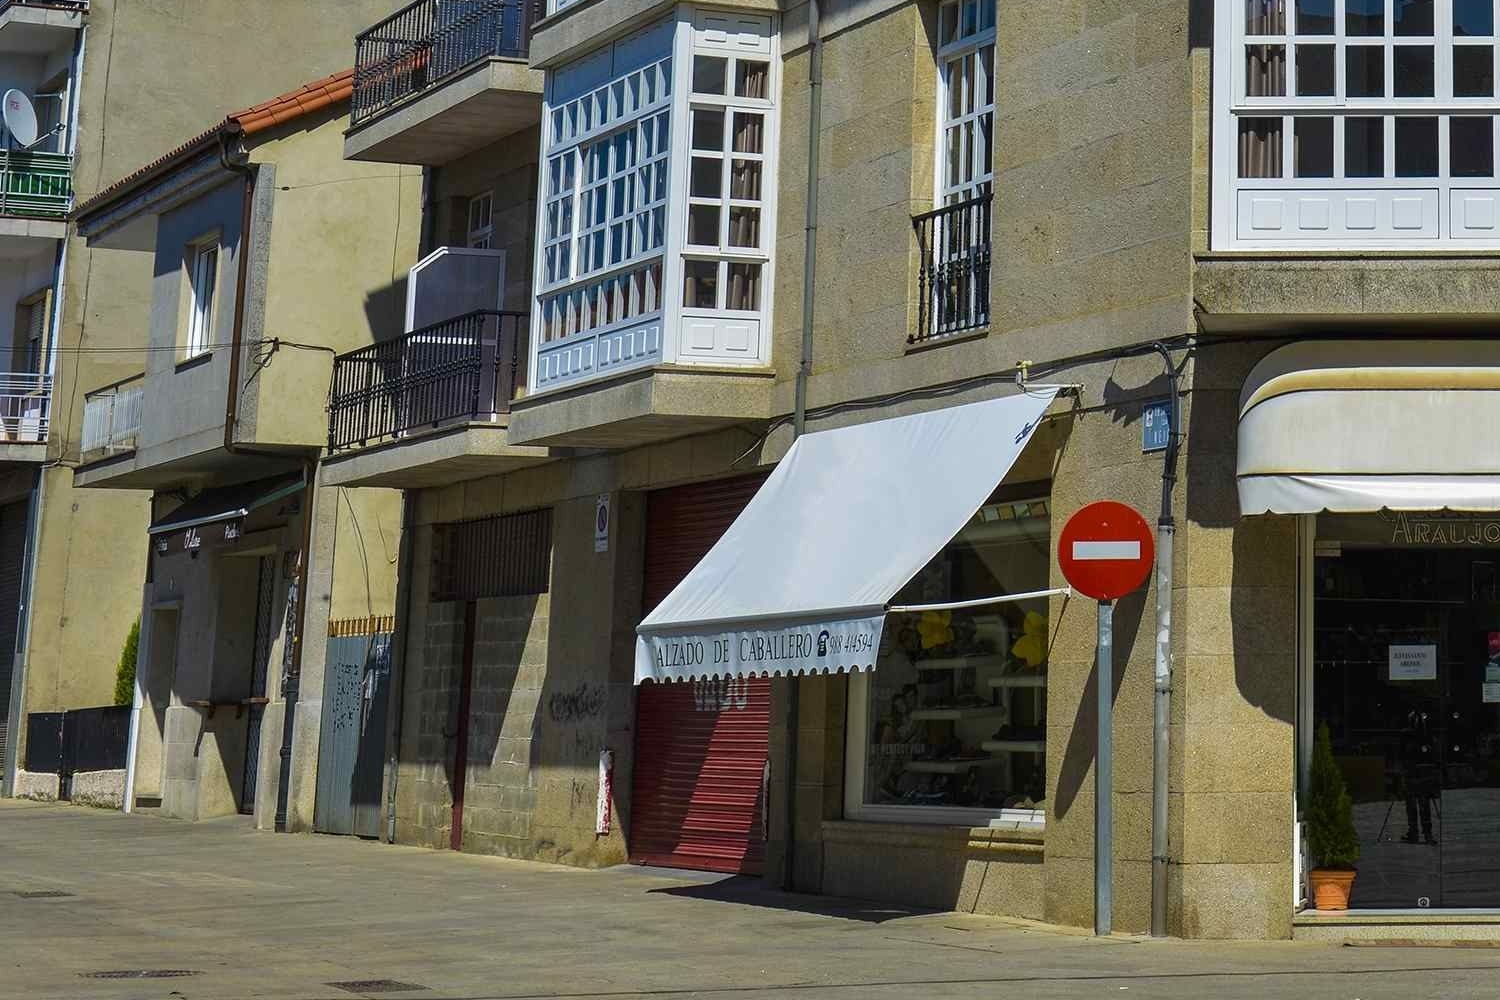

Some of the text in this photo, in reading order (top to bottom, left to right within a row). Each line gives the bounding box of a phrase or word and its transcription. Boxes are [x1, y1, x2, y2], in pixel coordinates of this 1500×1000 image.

[656, 641, 705, 668] ALZADO
[714, 639, 729, 664] DE
[740, 632, 813, 662] CABALLERO
